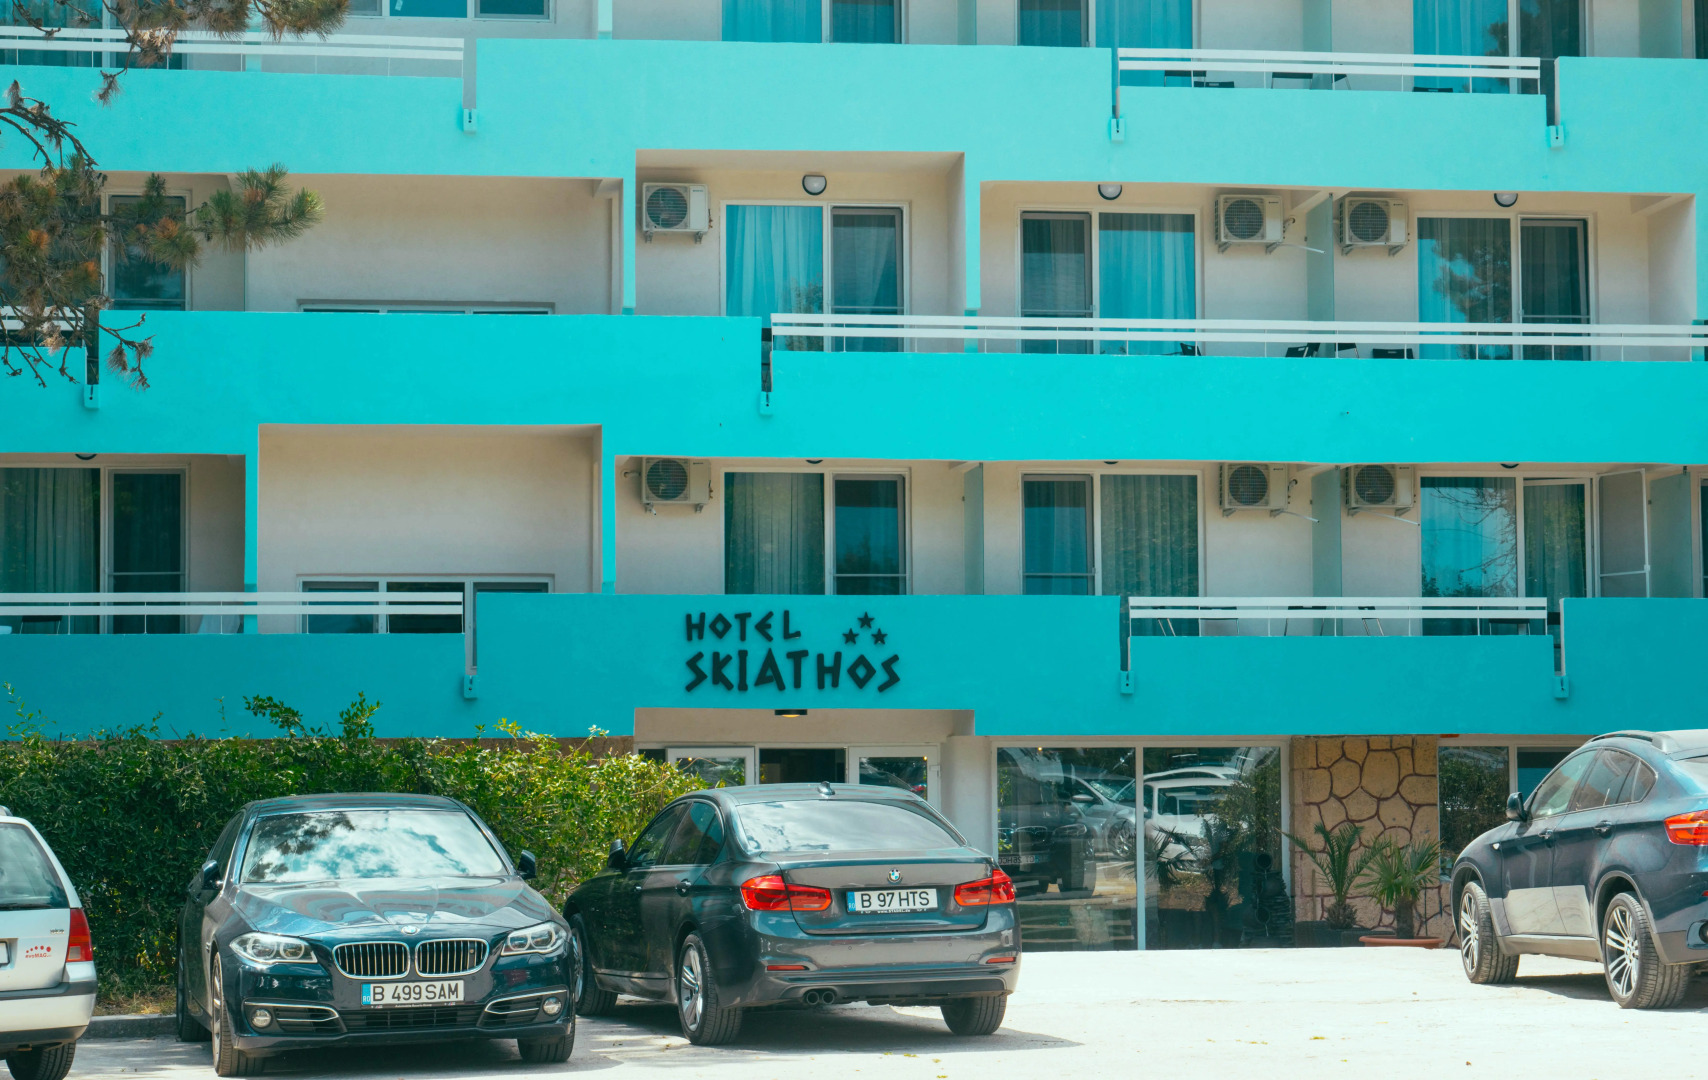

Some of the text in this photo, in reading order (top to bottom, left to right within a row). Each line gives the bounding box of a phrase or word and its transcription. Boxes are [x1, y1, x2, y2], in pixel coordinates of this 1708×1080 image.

[685, 609, 802, 642] HOTEL
[685, 647, 901, 693] SKIATHOS
[861, 891, 930, 909] B 97 HTS
[372, 983, 459, 1002] B 499 SAM
